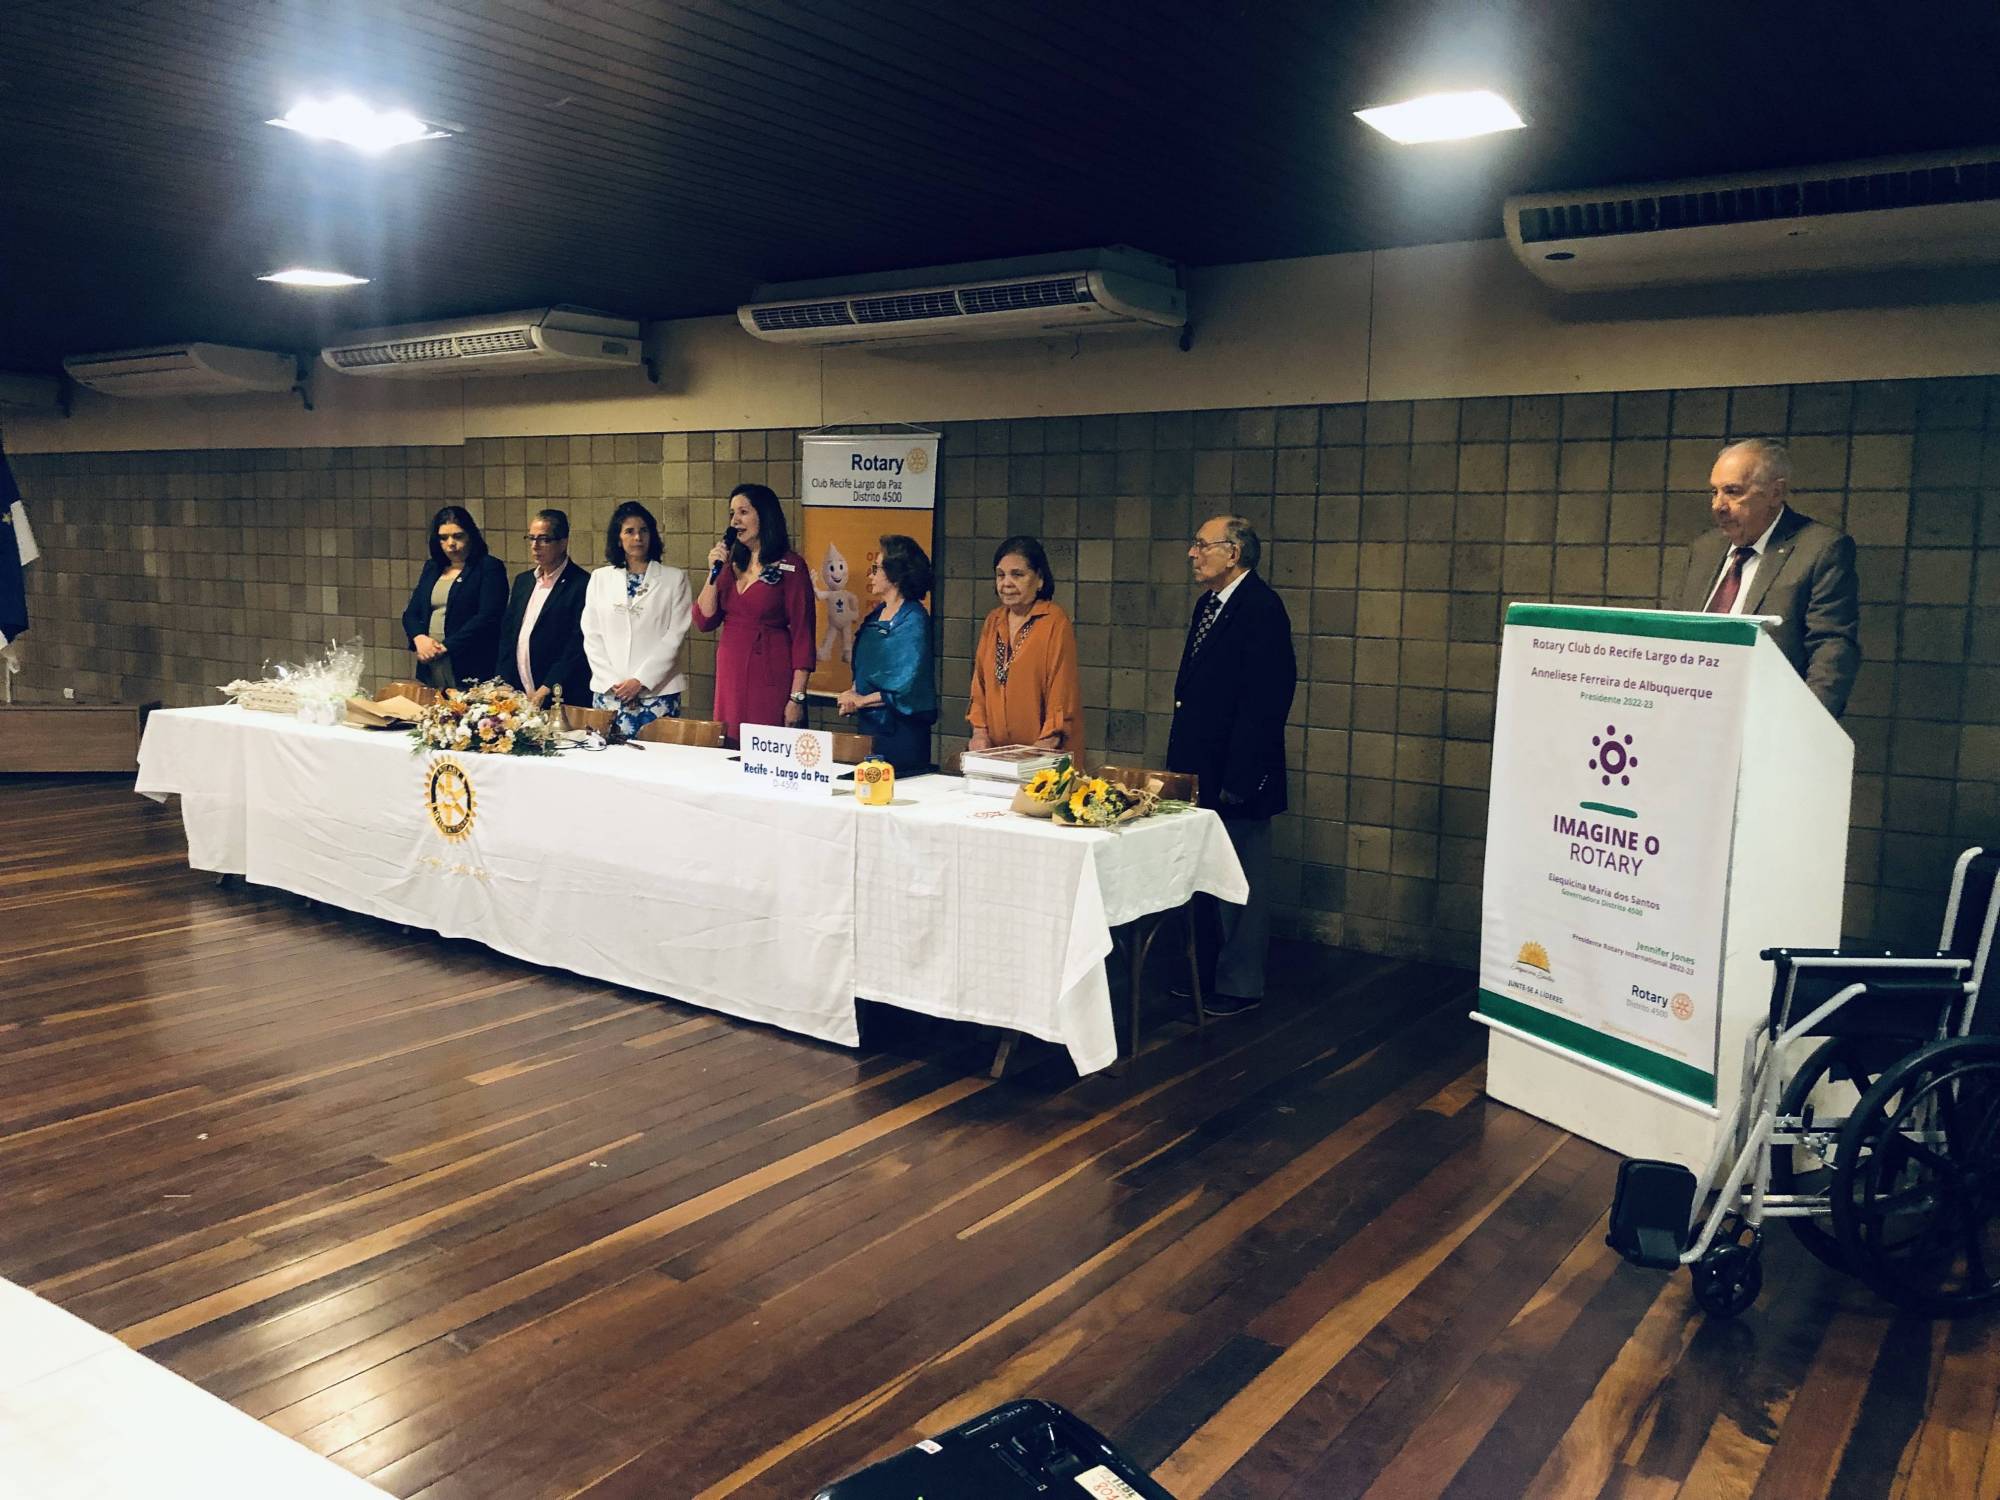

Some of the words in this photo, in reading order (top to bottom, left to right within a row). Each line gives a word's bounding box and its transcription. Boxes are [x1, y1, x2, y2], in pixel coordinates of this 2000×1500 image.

[851, 453, 904, 475] Rotary
[811, 478, 828, 488] Club
[829, 478, 852, 489] Recife
[853, 479, 875, 491] Largo
[876, 480, 887, 489] da
[888, 480, 902, 490] Paz
[853, 491, 880, 502] Distrito
[882, 491, 902, 502] 4500
[1532, 638, 1565, 653] Rotary
[1568, 642, 1591, 654] Club
[1593, 644, 1606, 655] do
[1609, 646, 1643, 660] Recife
[1646, 650, 1677, 665] Largo
[1680, 653, 1694, 665] da
[1698, 655, 1720, 668] Paz
[1531, 667, 1578, 682] Anneliese
[1580, 673, 1620, 687] Ferreira
[1623, 678, 1637, 689] de
[1638, 680, 1713, 700] Albuquerque
[1580, 691, 1621, 705] Presidente
[752, 736, 792, 757] Rotary
[744, 763, 768, 775] Recife
[776, 766, 799, 781] Largo
[801, 771, 812, 781] da
[814, 771, 829, 783] Paz
[1553, 814, 1639, 851] IMAGINE
[1644, 835, 1660, 855] O
[1570, 842, 1643, 876] ROTARY
[1561, 888, 1600, 905] Governadora
[1601, 900, 1626, 912] Distrito
[1589, 884, 1612, 898] Maria
[1614, 891, 1629, 902] dos
[1631, 895, 1660, 910] Santos
[1603, 943, 1624, 956] Rotary
[1636, 941, 1669, 957] Jennifer
[1671, 951, 1695, 965] Jones
[1631, 984, 1668, 1008] Rotary
